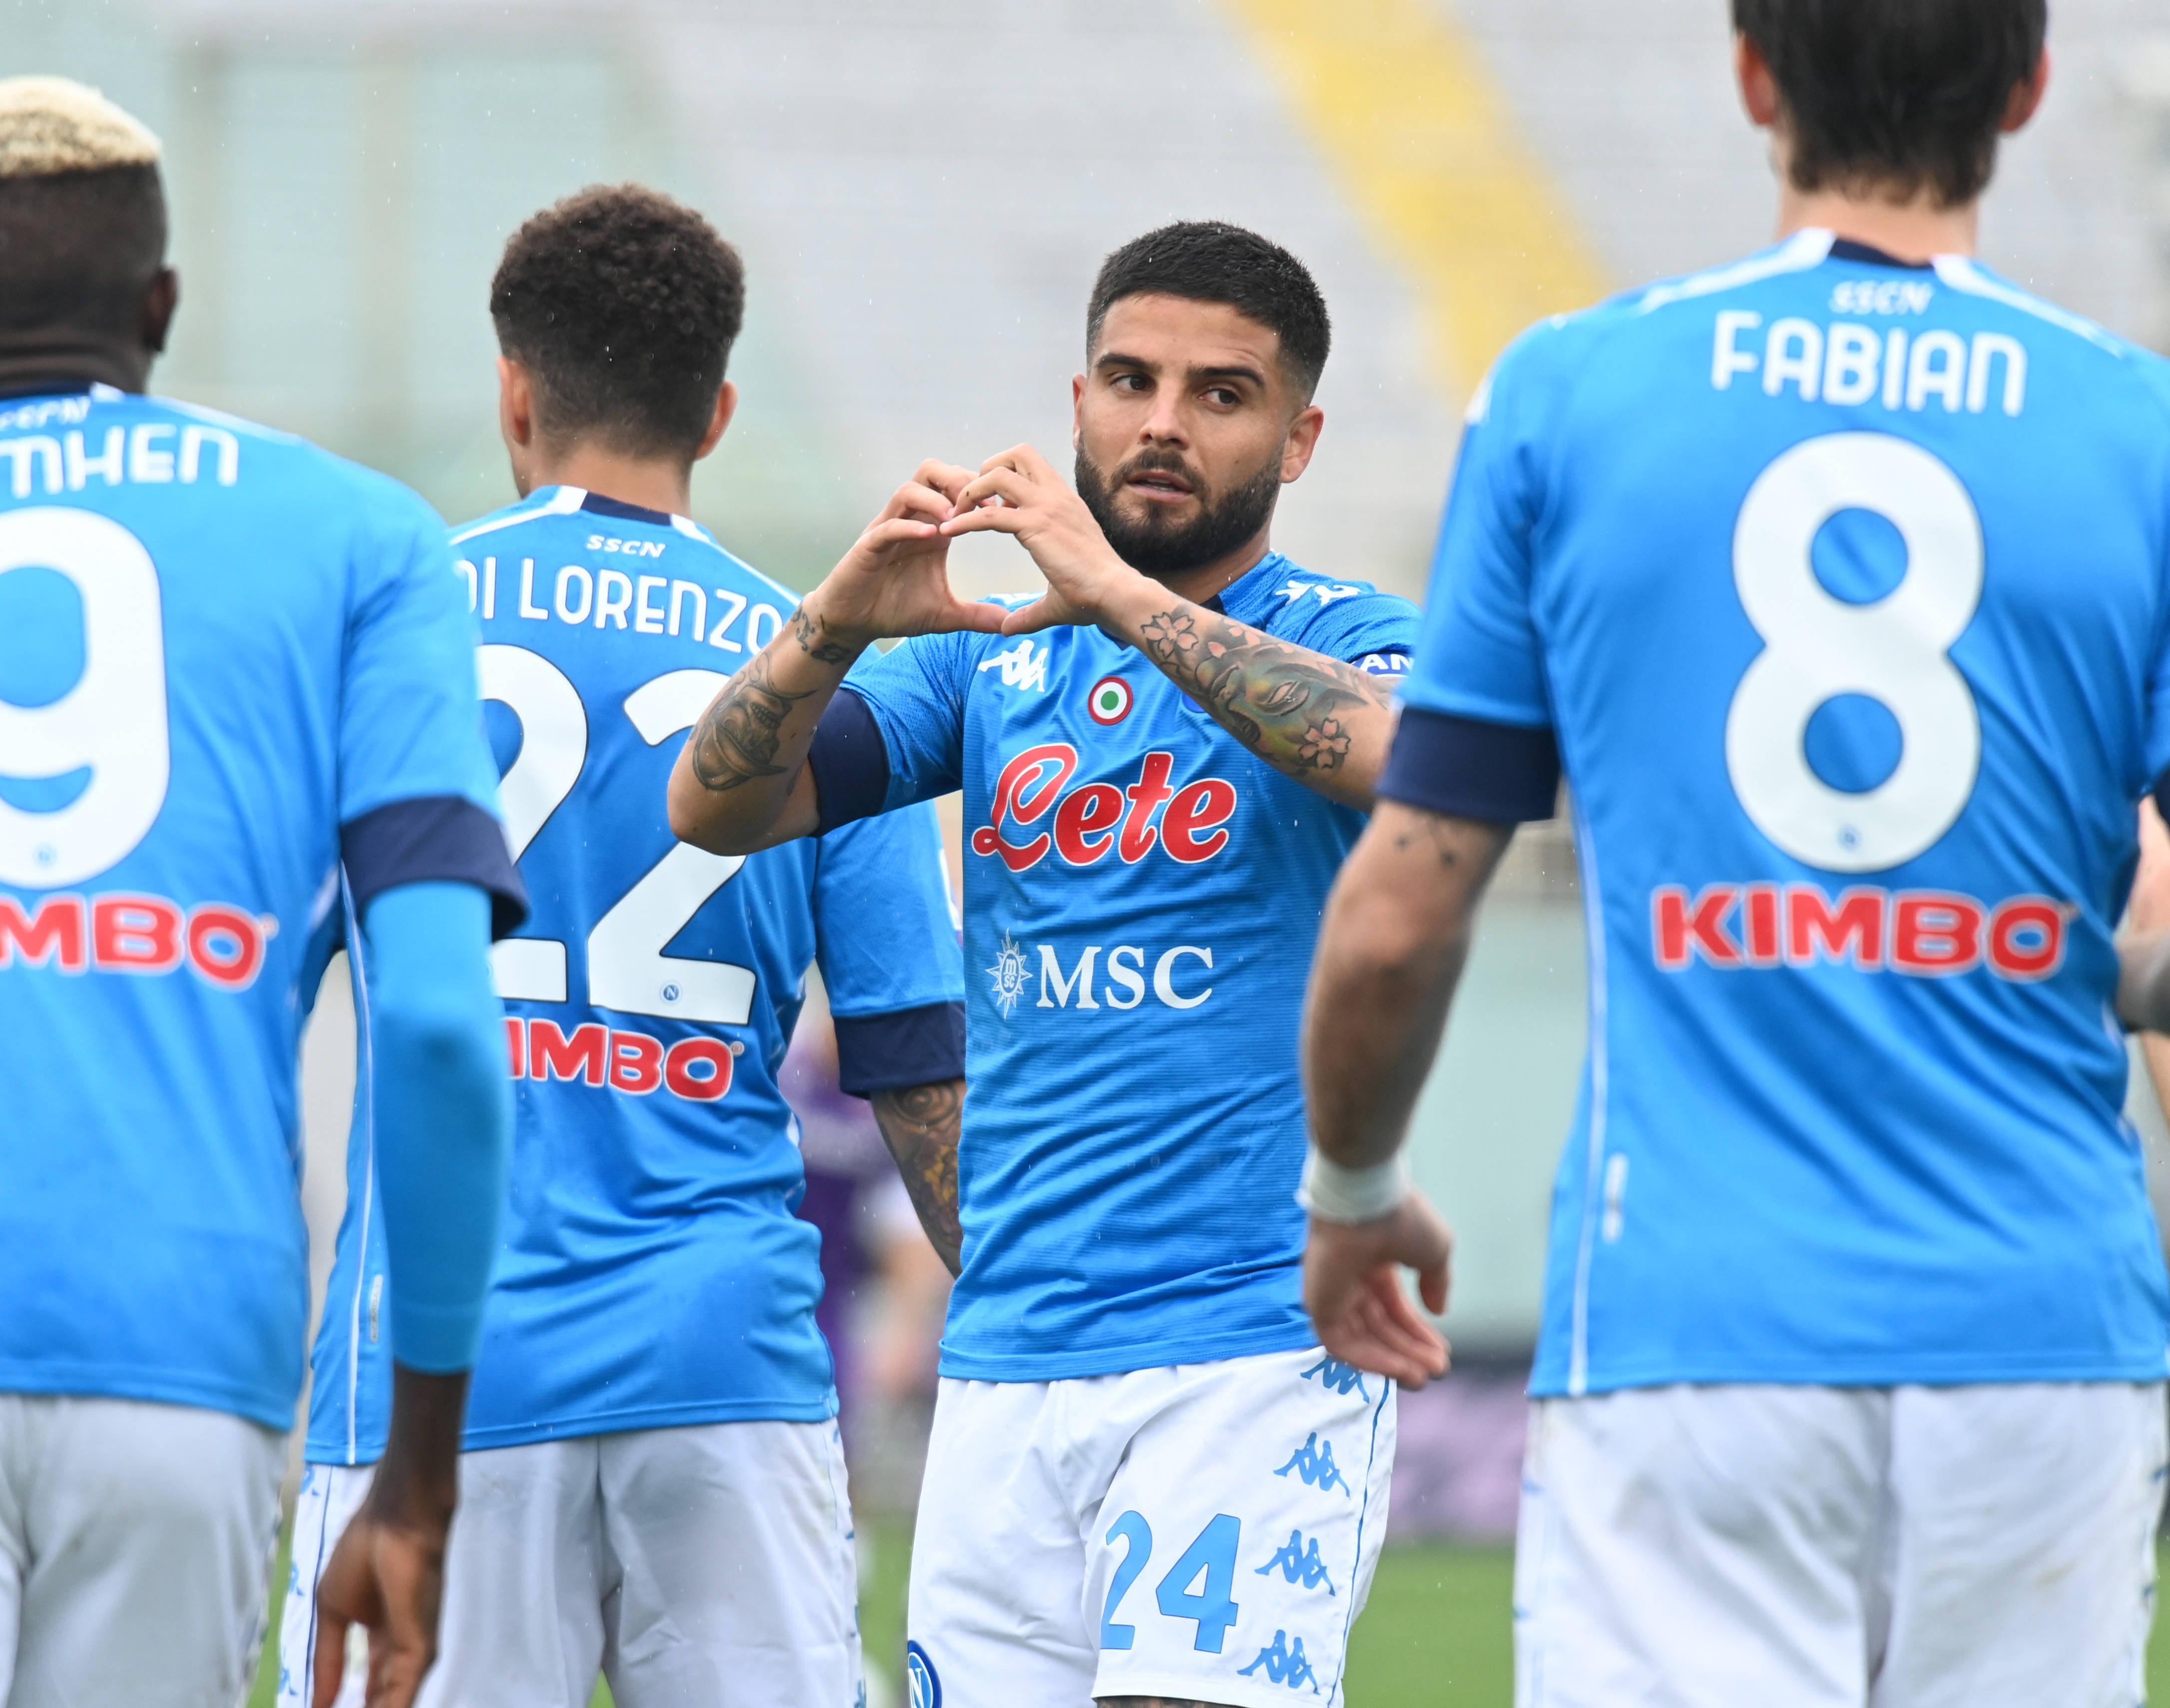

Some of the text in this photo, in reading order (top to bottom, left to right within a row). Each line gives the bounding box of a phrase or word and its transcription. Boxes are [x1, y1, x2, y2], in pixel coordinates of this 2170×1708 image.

[1710, 309, 2028, 417] FABIAN
[587, 534, 666, 558] SSCN
[519, 558, 785, 657] LORENZO
[1726, 429, 1985, 873] 8
[0, 505, 171, 890] 9
[1349, 653, 1415, 673] AN
[474, 644, 756, 1026] 22
[972, 743, 1237, 872] Lete
[1036, 945, 1214, 1009] MSC
[1651, 881, 2068, 984] KIMBO
[1101, 1510, 1240, 1654] 24
